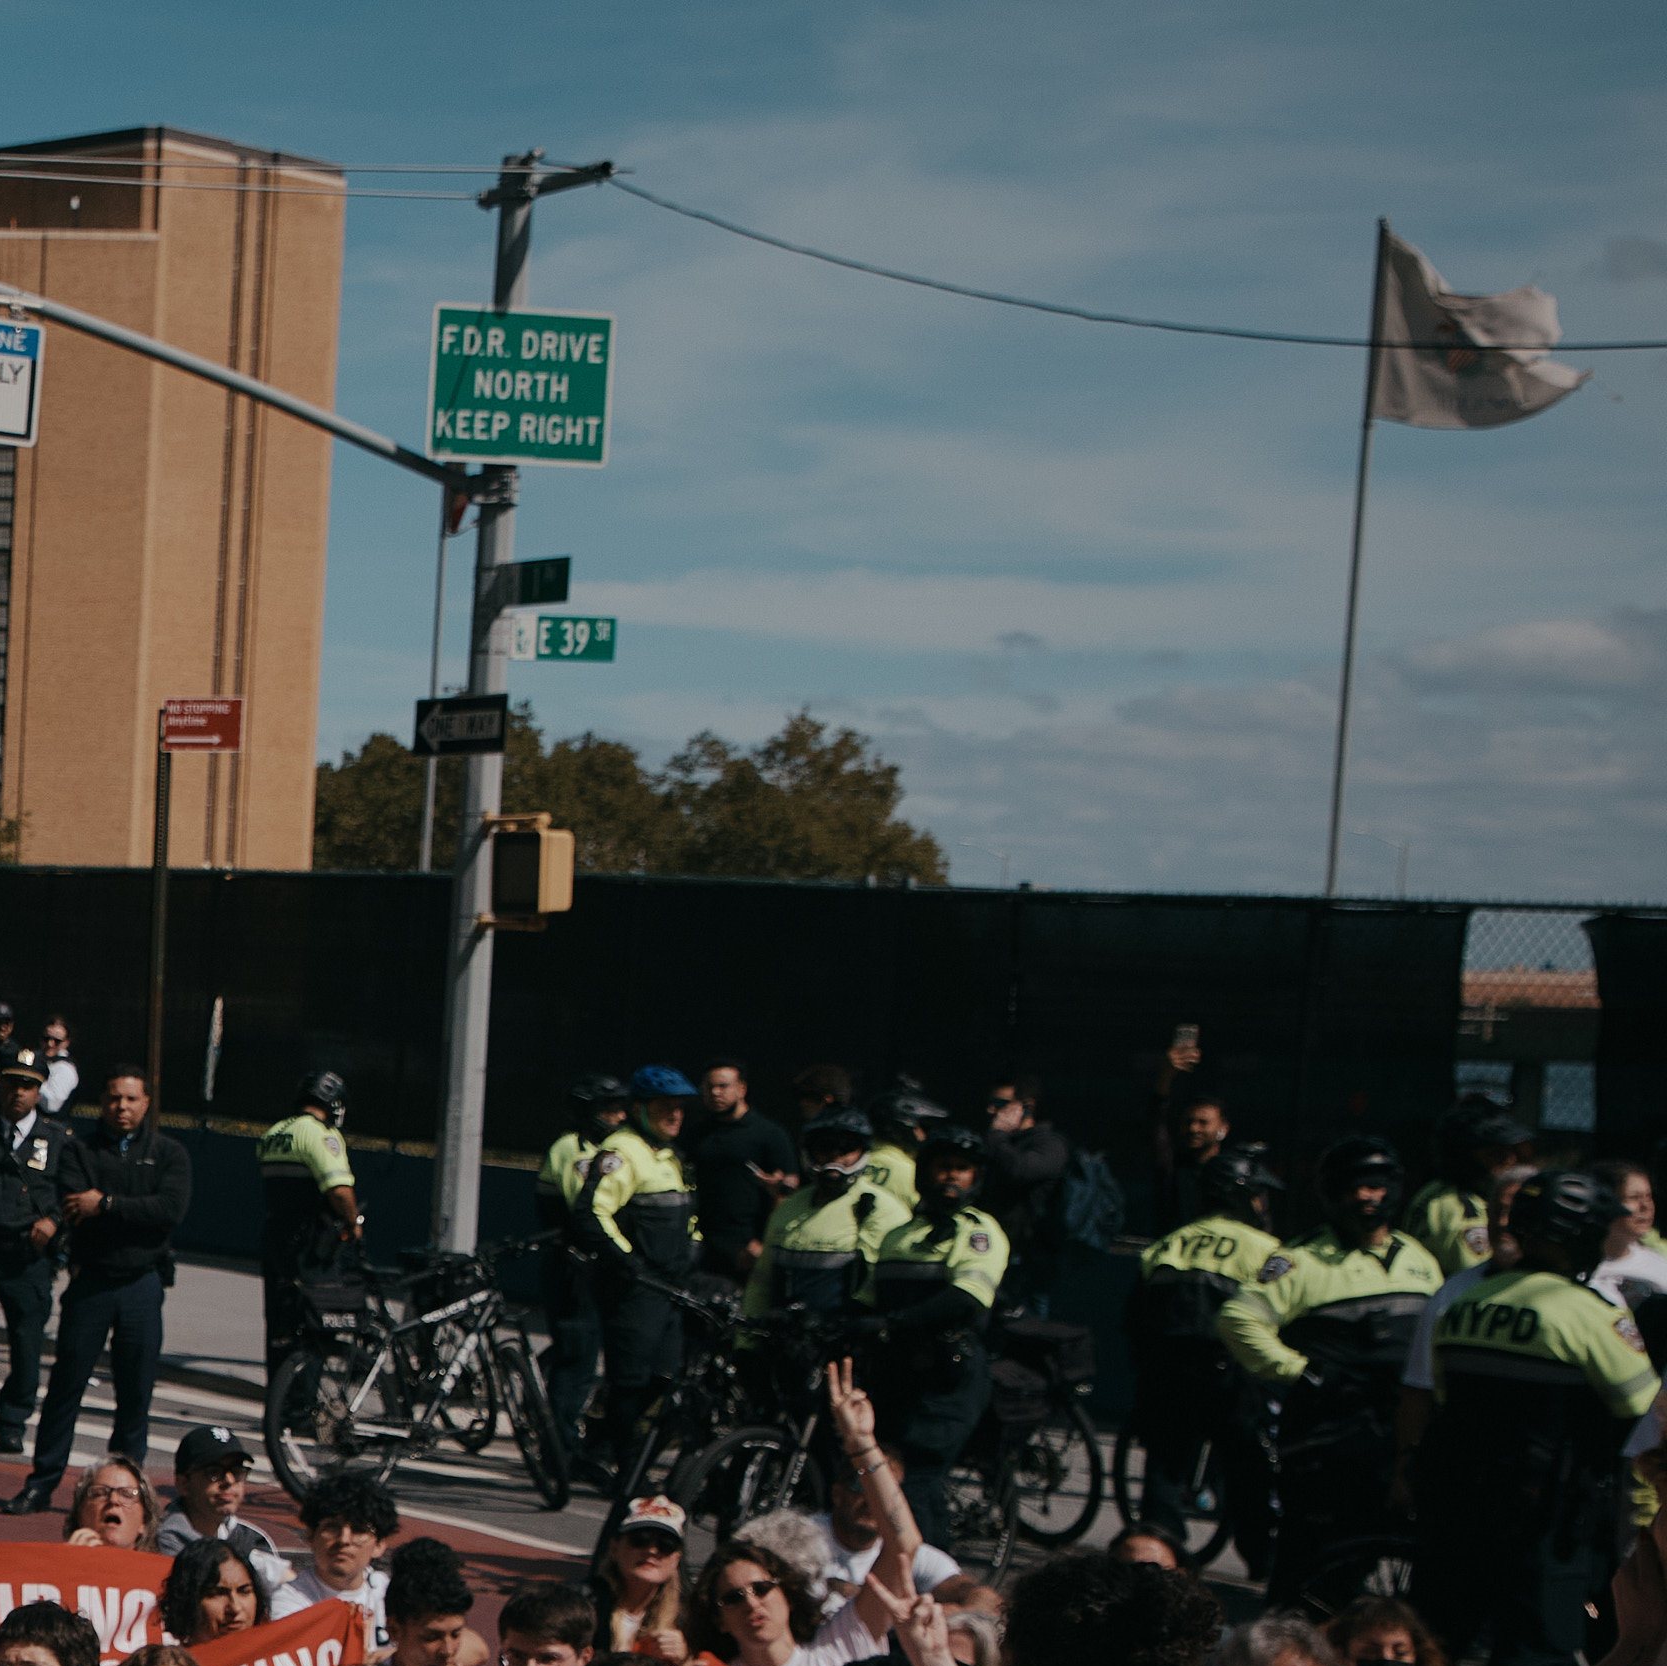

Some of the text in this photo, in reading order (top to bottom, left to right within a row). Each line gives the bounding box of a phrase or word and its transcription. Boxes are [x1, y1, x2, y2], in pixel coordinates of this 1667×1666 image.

[441, 324, 604, 365] F.D.R. DRIVE
[473, 368, 569, 403] NORTH
[435, 408, 601, 446] KEEP RIGHT
[538, 620, 553, 655] E
[560, 620, 590, 656] 39
[1155, 1232, 1237, 1264] NYPD
[1439, 1300, 1539, 1341] NYPD
[76, 1586, 157, 1655] NO
